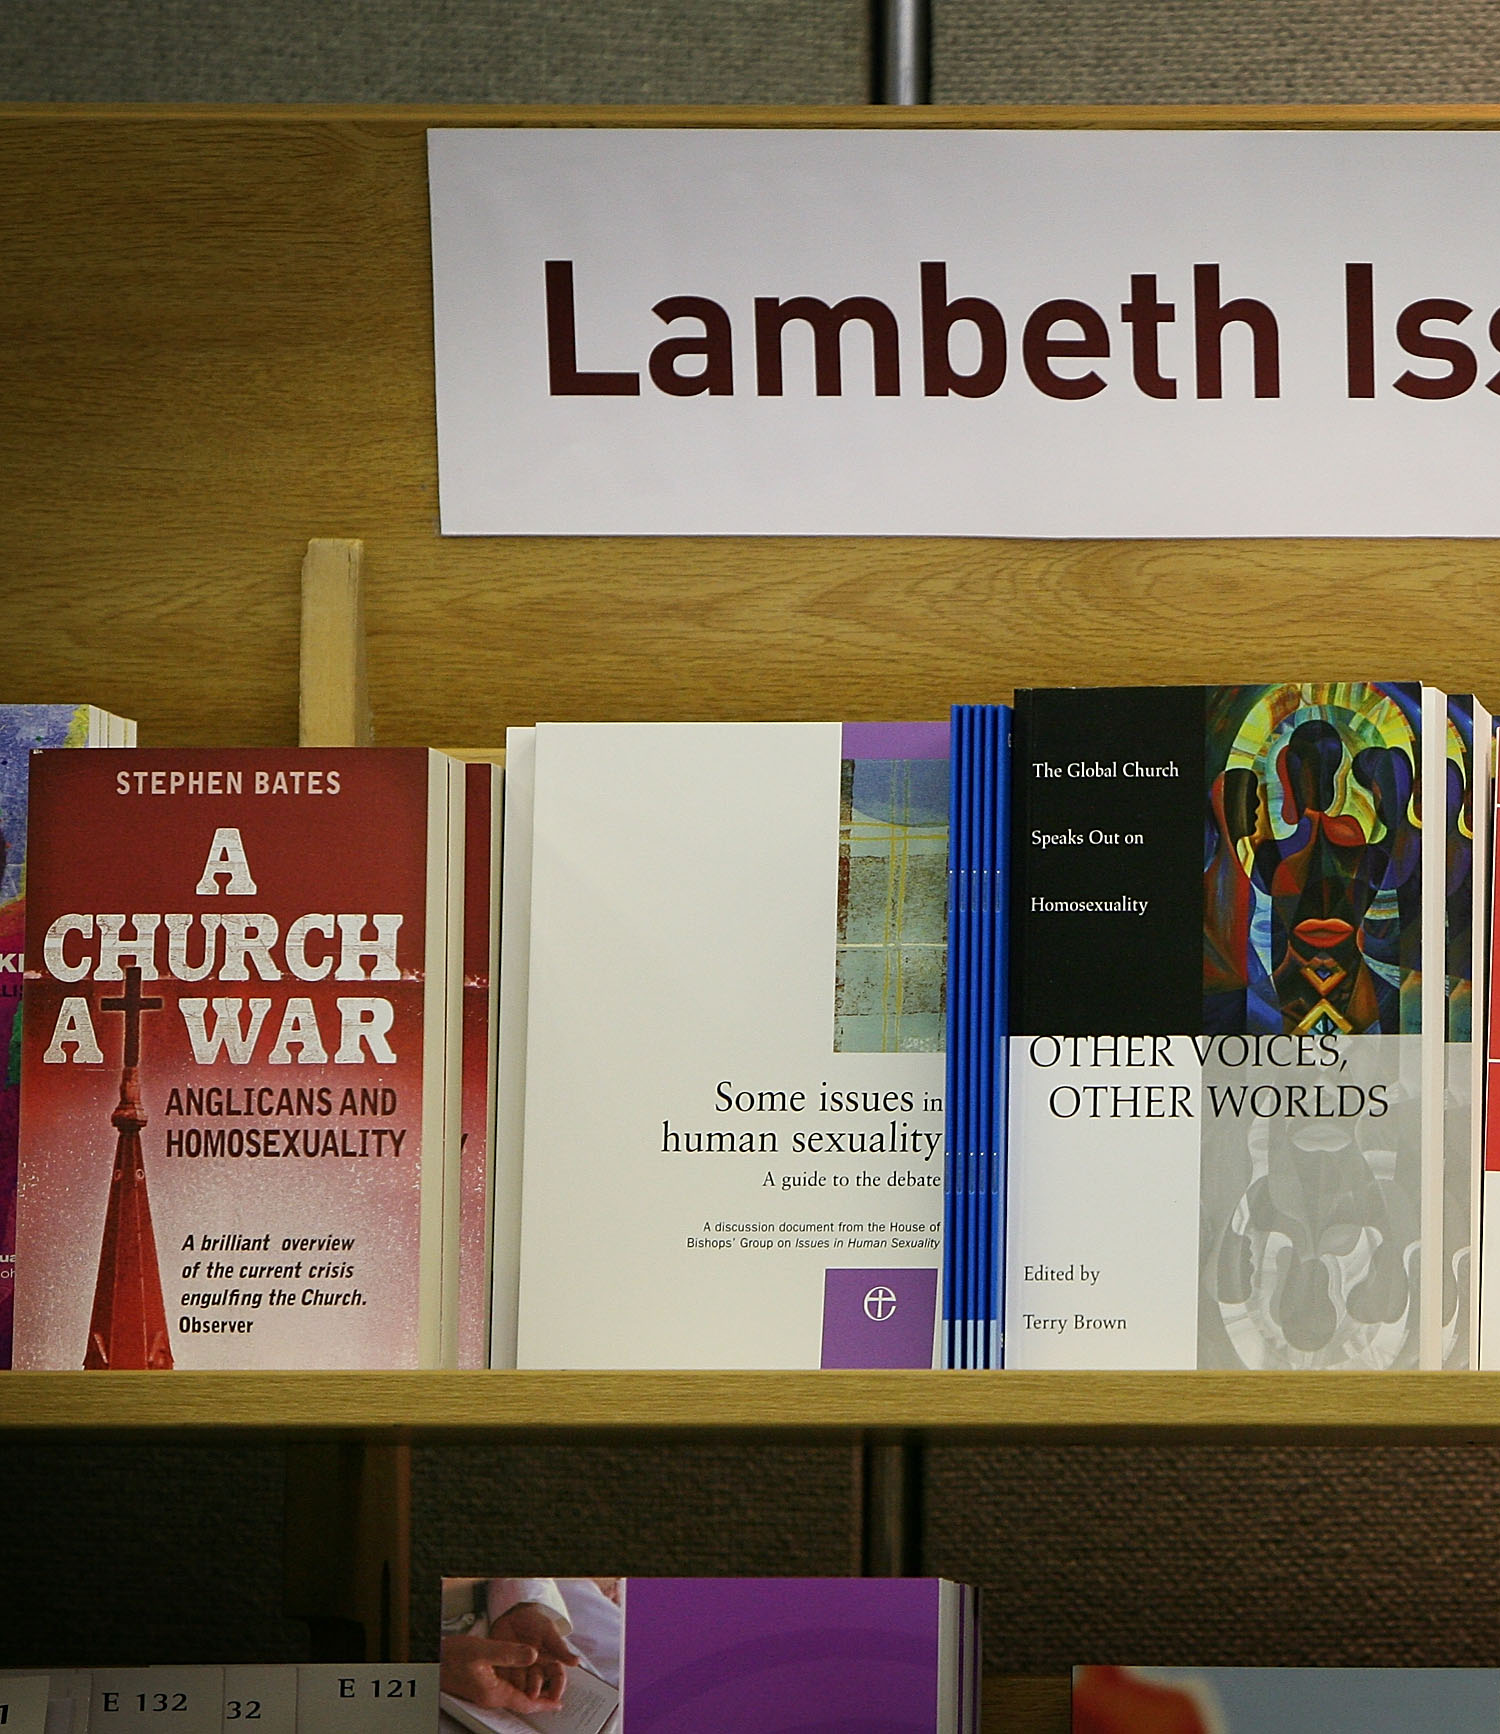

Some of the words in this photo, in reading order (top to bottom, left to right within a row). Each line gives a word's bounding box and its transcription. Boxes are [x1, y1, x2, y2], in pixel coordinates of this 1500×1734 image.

[545, 260, 1281, 400] Lambeth
[1032, 762, 1062, 778] The
[1067, 761, 1117, 778] Global
[1122, 761, 1180, 778] Church
[116, 771, 243, 796] STEPHEN
[255, 771, 341, 796] BATES
[1031, 829, 1084, 849] Speaks
[1089, 829, 1120, 845] Out
[1124, 833, 1144, 845] on
[195, 828, 257, 895] A
[1031, 895, 1148, 916] Homosexuality
[43, 913, 403, 982] CHURCH
[178, 996, 397, 1064] WAR
[1029, 1034, 1175, 1068] OTHER
[1188, 1034, 1349, 1072] VOICES,
[165, 1087, 332, 1116] ANGLICANS
[339, 1088, 397, 1116] AND
[714, 1081, 806, 1113] Some
[819, 1081, 914, 1113] issues
[923, 1092, 943, 1112] in
[1049, 1085, 1194, 1118] OTHER
[1207, 1084, 1389, 1118] WORLDS
[166, 1129, 406, 1157] HOMOSEXUALITY
[661, 1120, 778, 1153] human
[792, 1120, 943, 1162] sexuality
[762, 1171, 776, 1187] A
[782, 1171, 827, 1191] guide
[833, 1173, 849, 1187] to
[856, 1171, 881, 1187] the
[887, 1171, 941, 1187] debate
[703, 1222, 711, 1232] A
[715, 1221, 775, 1232] discussion
[778, 1221, 834, 1232] document
[838, 1221, 863, 1232] from
[868, 1221, 886, 1232] the
[890, 1221, 925, 1232] House
[929, 1221, 941, 1232] of
[182, 1235, 194, 1251] A
[201, 1234, 270, 1251] brilliant
[281, 1236, 355, 1251] overview
[740, 1238, 773, 1250] Group
[777, 1240, 791, 1248] on
[795, 1238, 829, 1248] Issues
[834, 1238, 843, 1248] in
[848, 1238, 887, 1248] Human
[891, 1238, 940, 1250] Sexuality
[182, 1262, 201, 1279] of
[206, 1262, 233, 1279] the
[239, 1262, 301, 1279] current
[308, 1262, 354, 1279] crisis
[1024, 1264, 1074, 1281] Edited
[1080, 1264, 1100, 1285] by
[181, 1289, 262, 1309] engulfing
[268, 1289, 296, 1306] the
[301, 1289, 367, 1306] Church.
[179, 1316, 253, 1334] Observer
[1023, 1314, 1067, 1334] Terry
[1074, 1314, 1127, 1330] Brown
[338, 1678, 355, 1698] E
[371, 1678, 418, 1698] 121
[102, 1692, 119, 1712] E
[136, 1692, 188, 1712] 132
